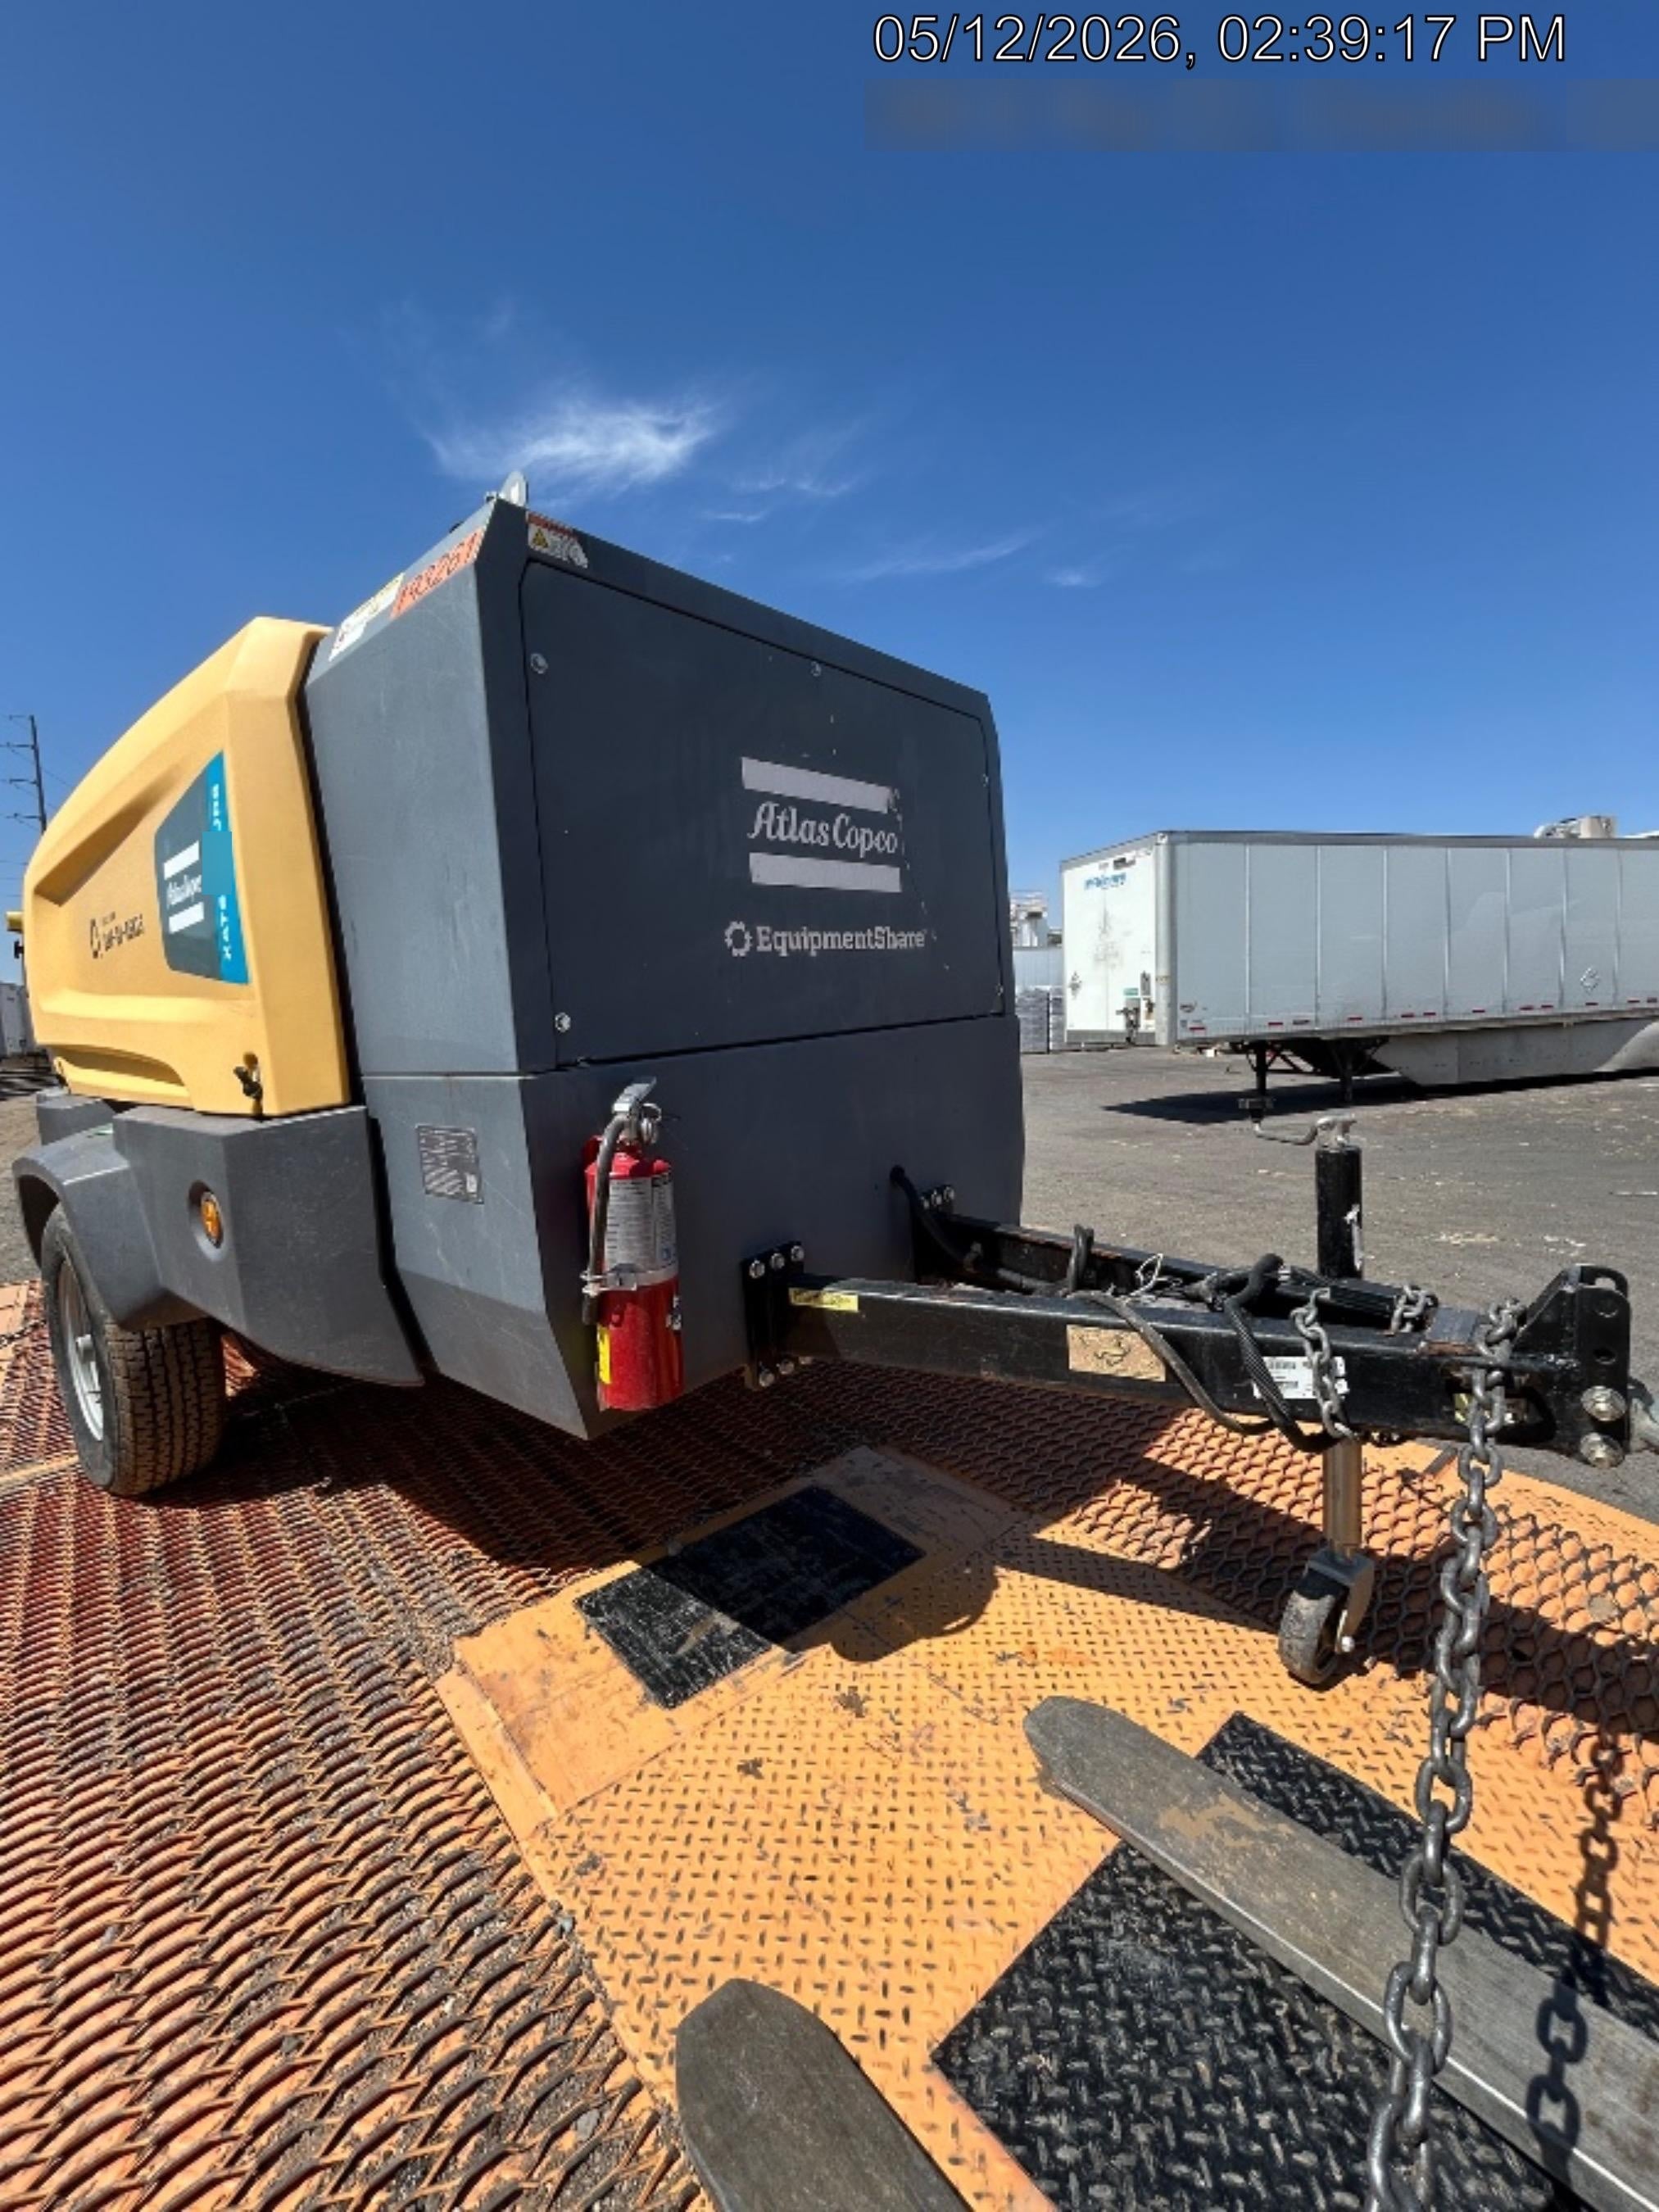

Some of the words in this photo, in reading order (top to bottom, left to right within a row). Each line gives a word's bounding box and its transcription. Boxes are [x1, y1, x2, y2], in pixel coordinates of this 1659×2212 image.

[746, 800, 830, 847] Atlas
[832, 812, 899, 859] Copco
[755, 925, 927, 957] EquipmentShare
